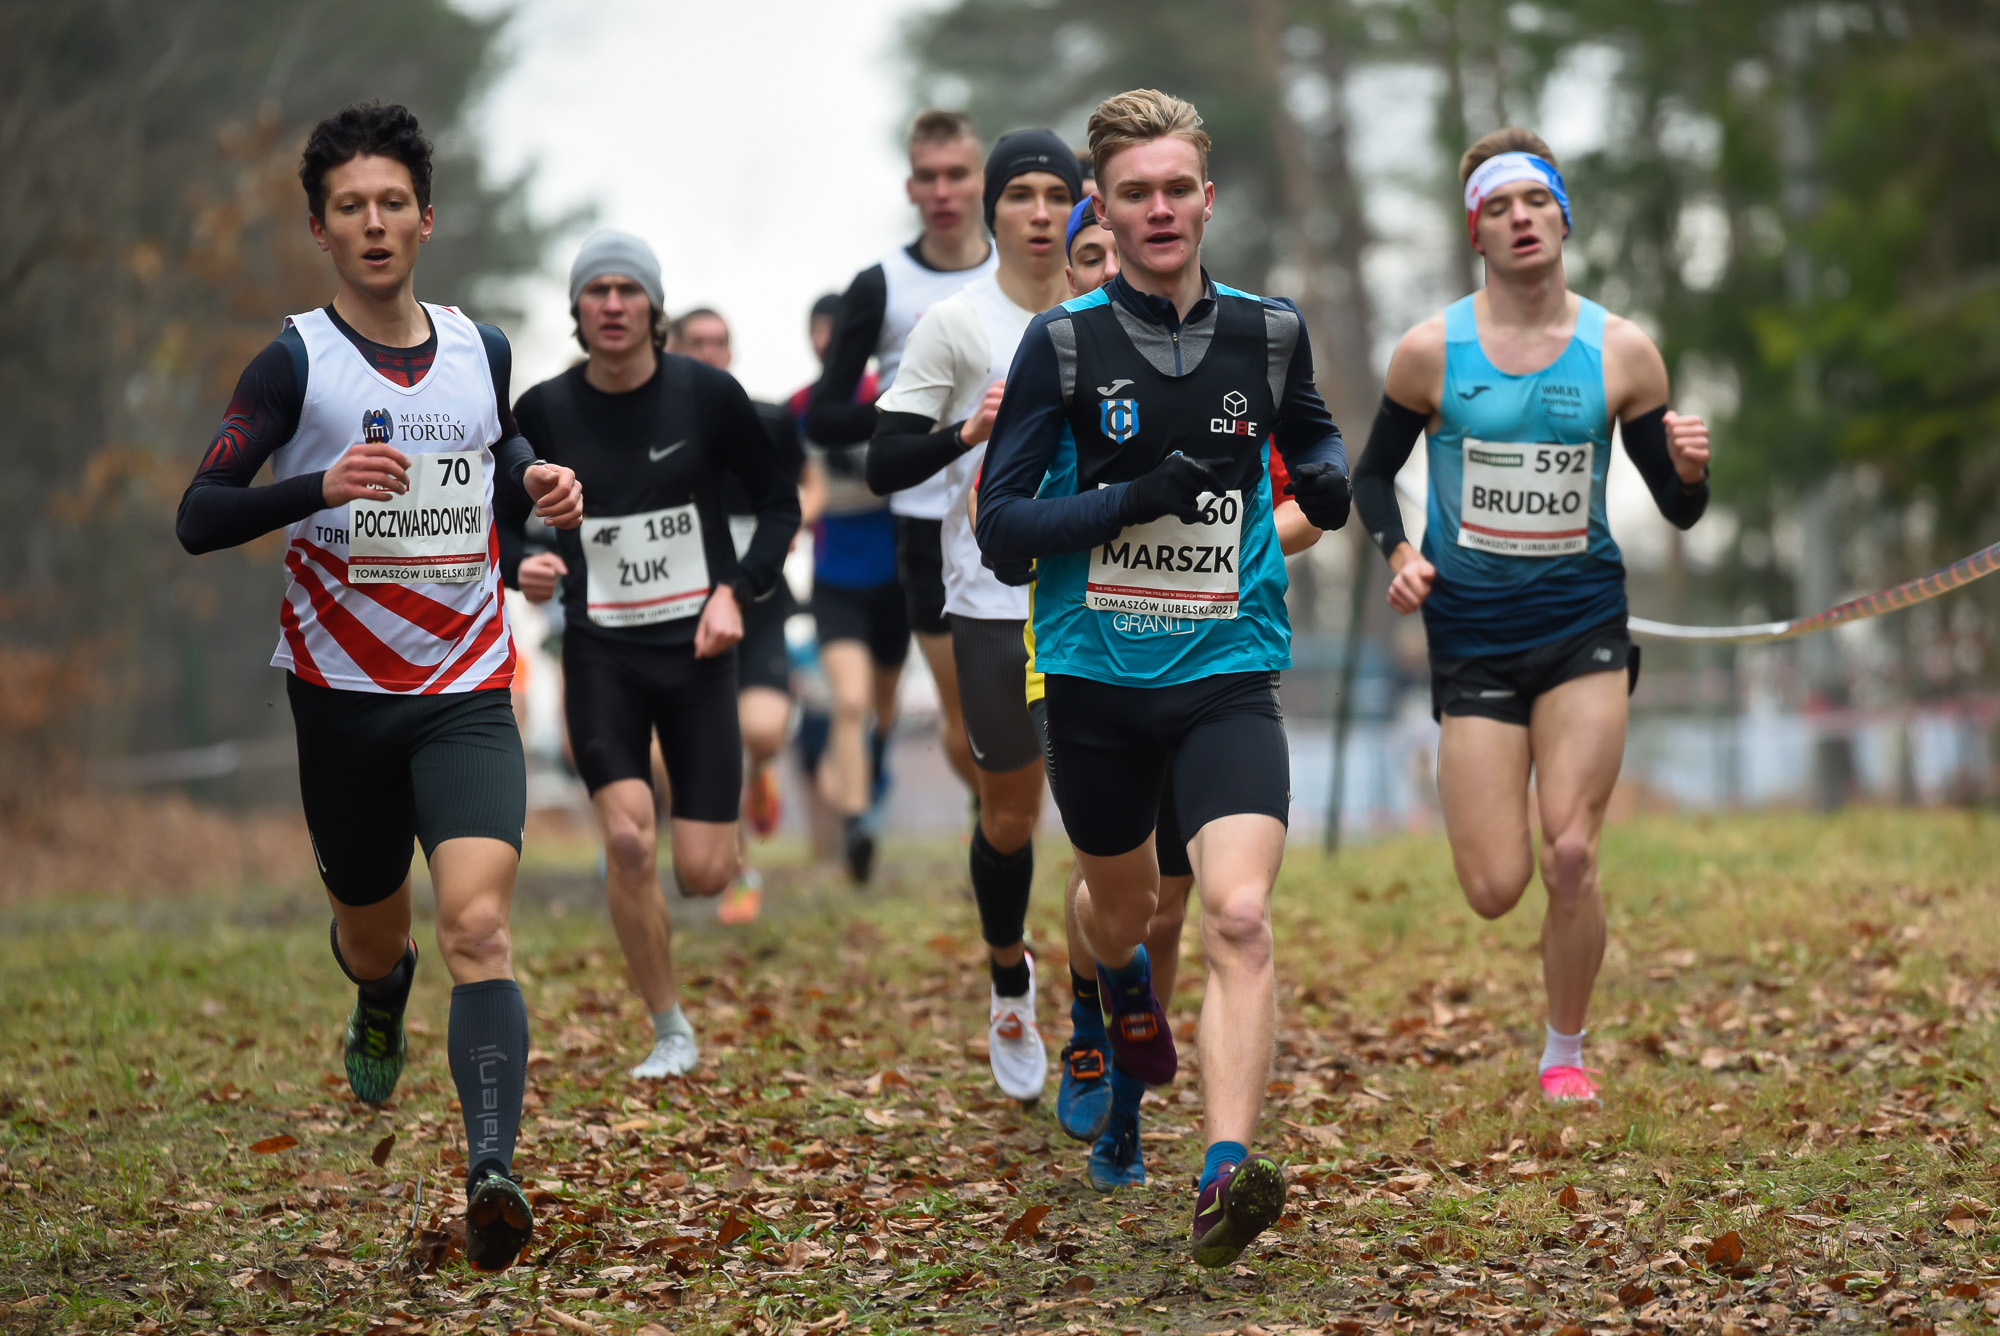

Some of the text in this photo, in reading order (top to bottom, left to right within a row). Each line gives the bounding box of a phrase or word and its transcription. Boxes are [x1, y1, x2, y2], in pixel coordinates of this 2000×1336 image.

[398, 420, 466, 441] TORUŃ
[400, 413, 451, 423] MIASTO
[1210, 418, 1257, 437] CUBE
[437, 457, 471, 487] 70
[1534, 449, 1586, 474] 592
[1471, 485, 1581, 516] BRUDŁO
[354, 506, 481, 538] POCZWARDOWSKI
[644, 511, 692, 542] 188
[592, 526, 621, 546] 4F
[1101, 541, 1235, 573] MARSZK
[355, 566, 481, 580] TOMASZÓW LUBELSKI 2021
[618, 556, 669, 587] ŻUK
[1093, 597, 1234, 615] TOMASZÓW LUBELSKI 2021
